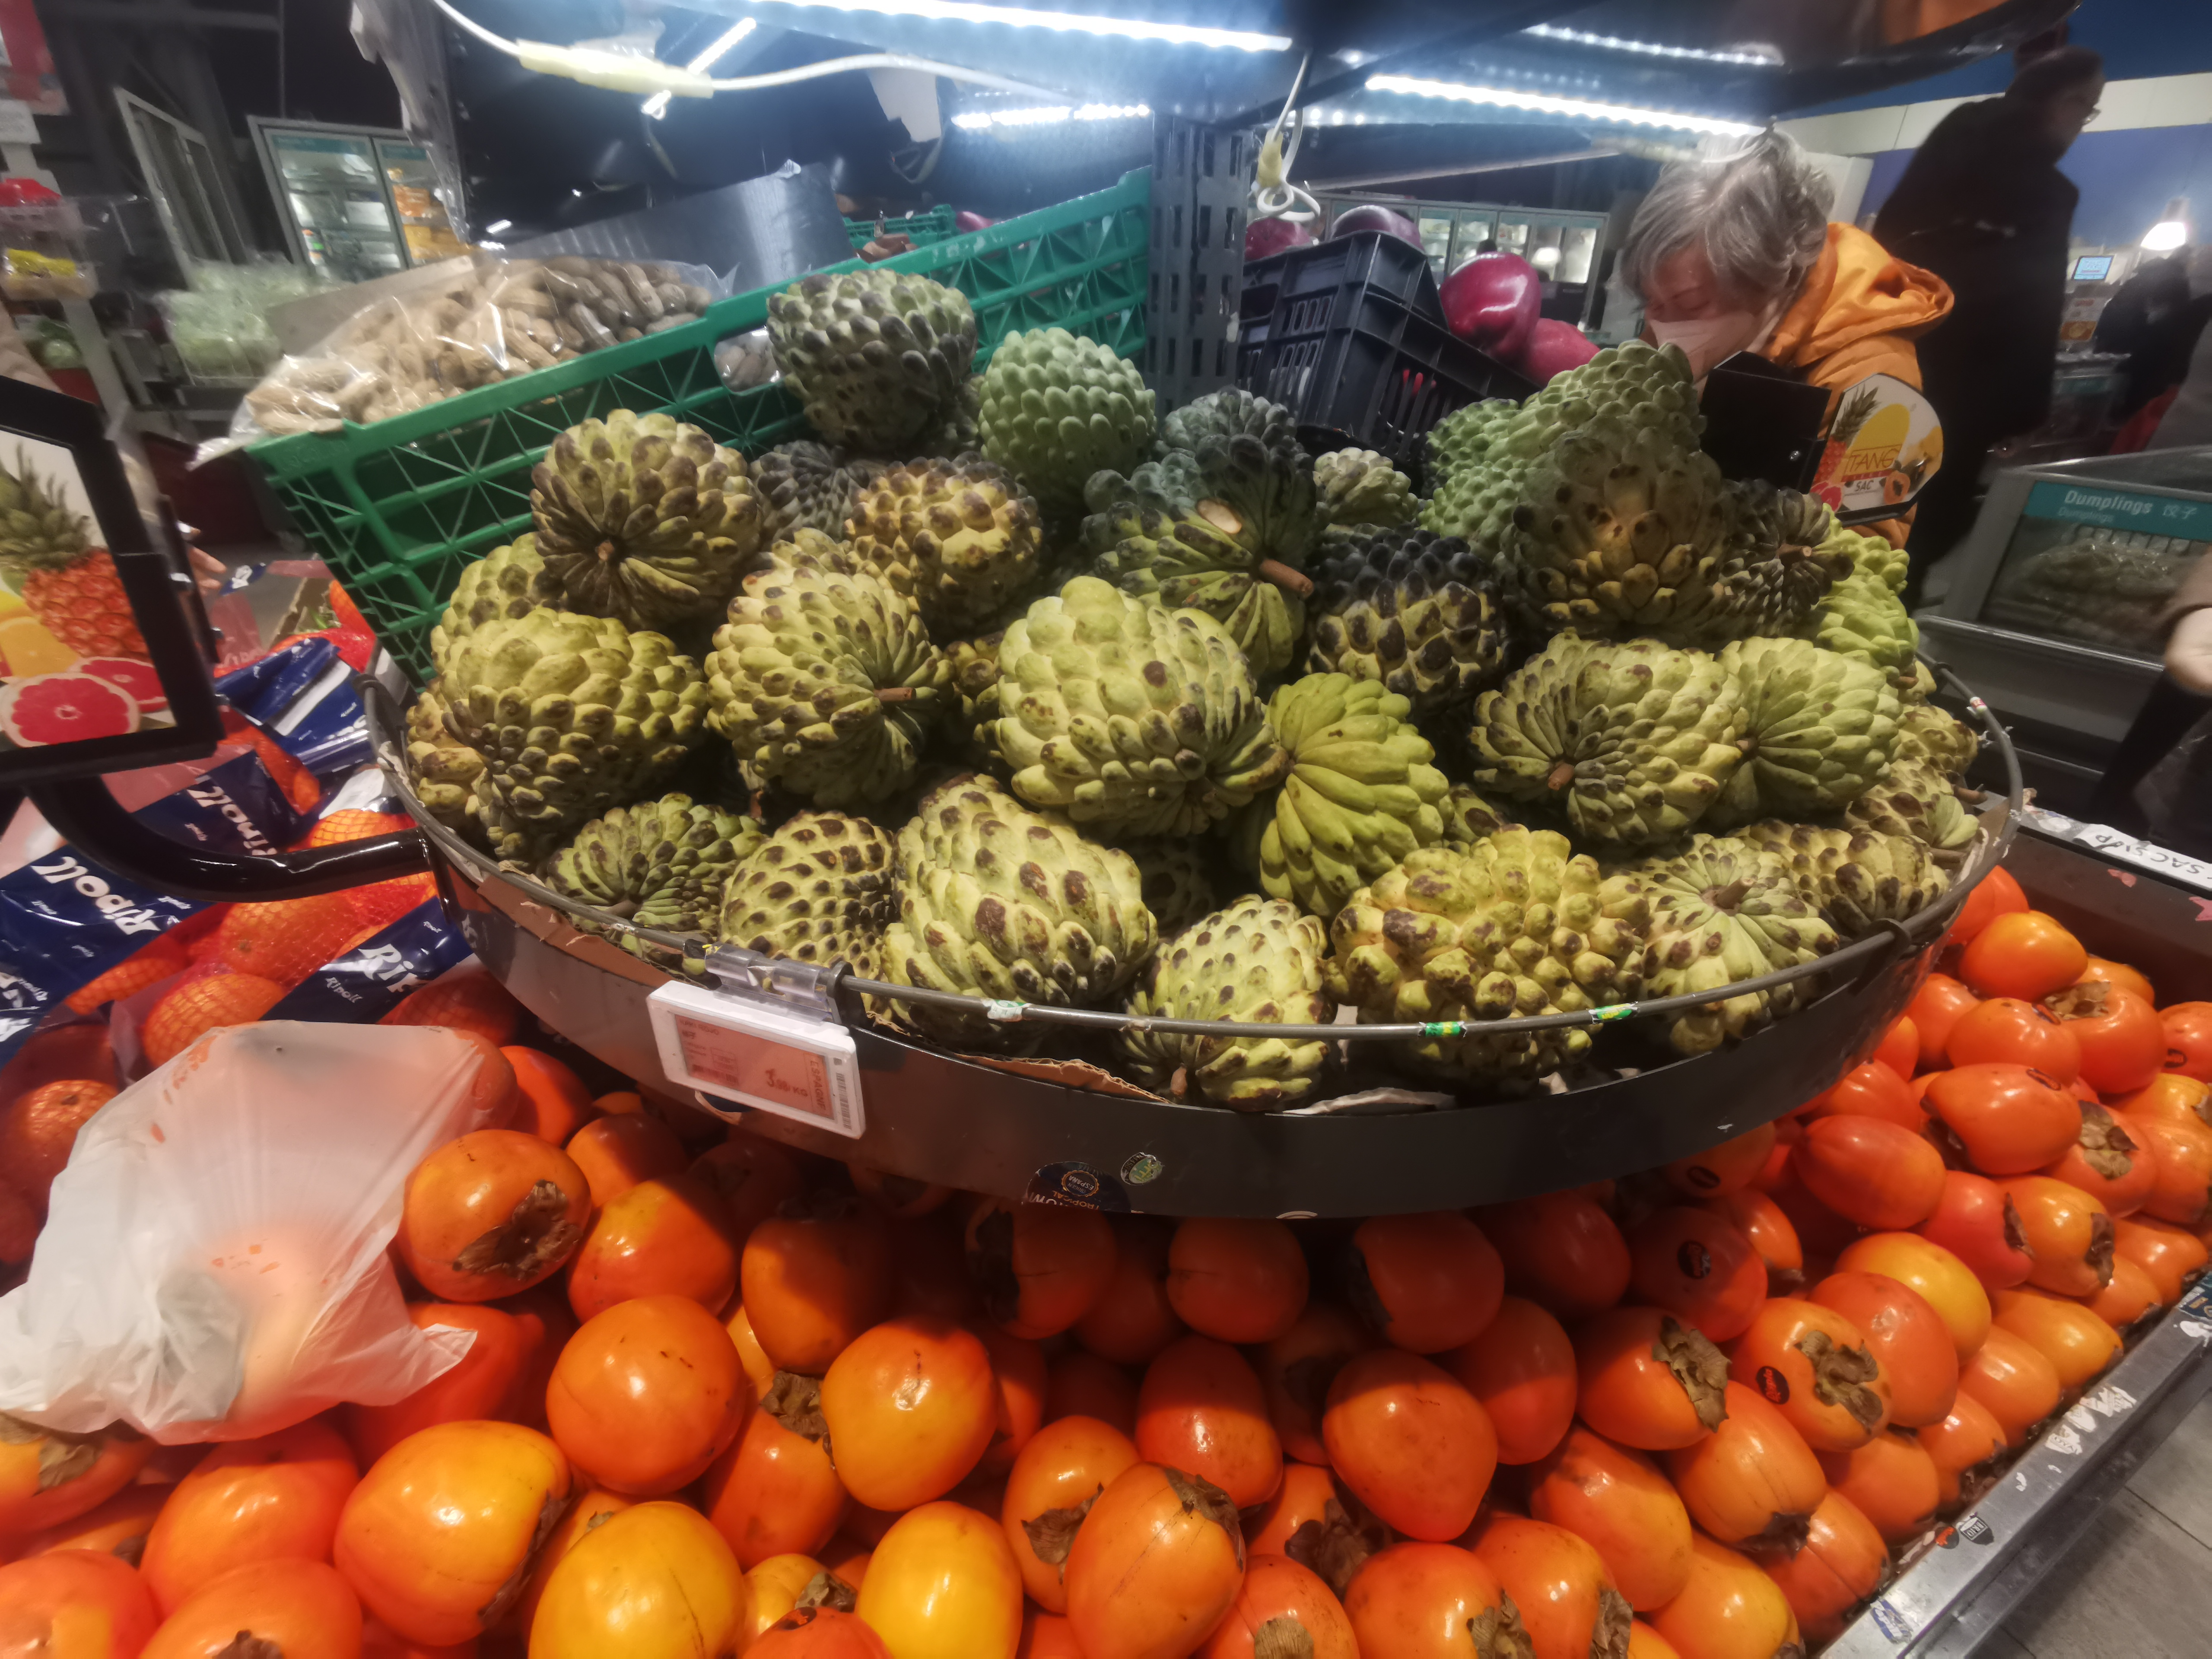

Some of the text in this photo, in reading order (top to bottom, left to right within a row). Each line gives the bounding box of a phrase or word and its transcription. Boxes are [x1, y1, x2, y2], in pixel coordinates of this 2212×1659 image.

[2064, 489, 2154, 515] Dumplings
[2150, 852, 2205, 874] SAC
[30, 856, 161, 935] Ripoll
[325, 977, 364, 1004] Ripoll
